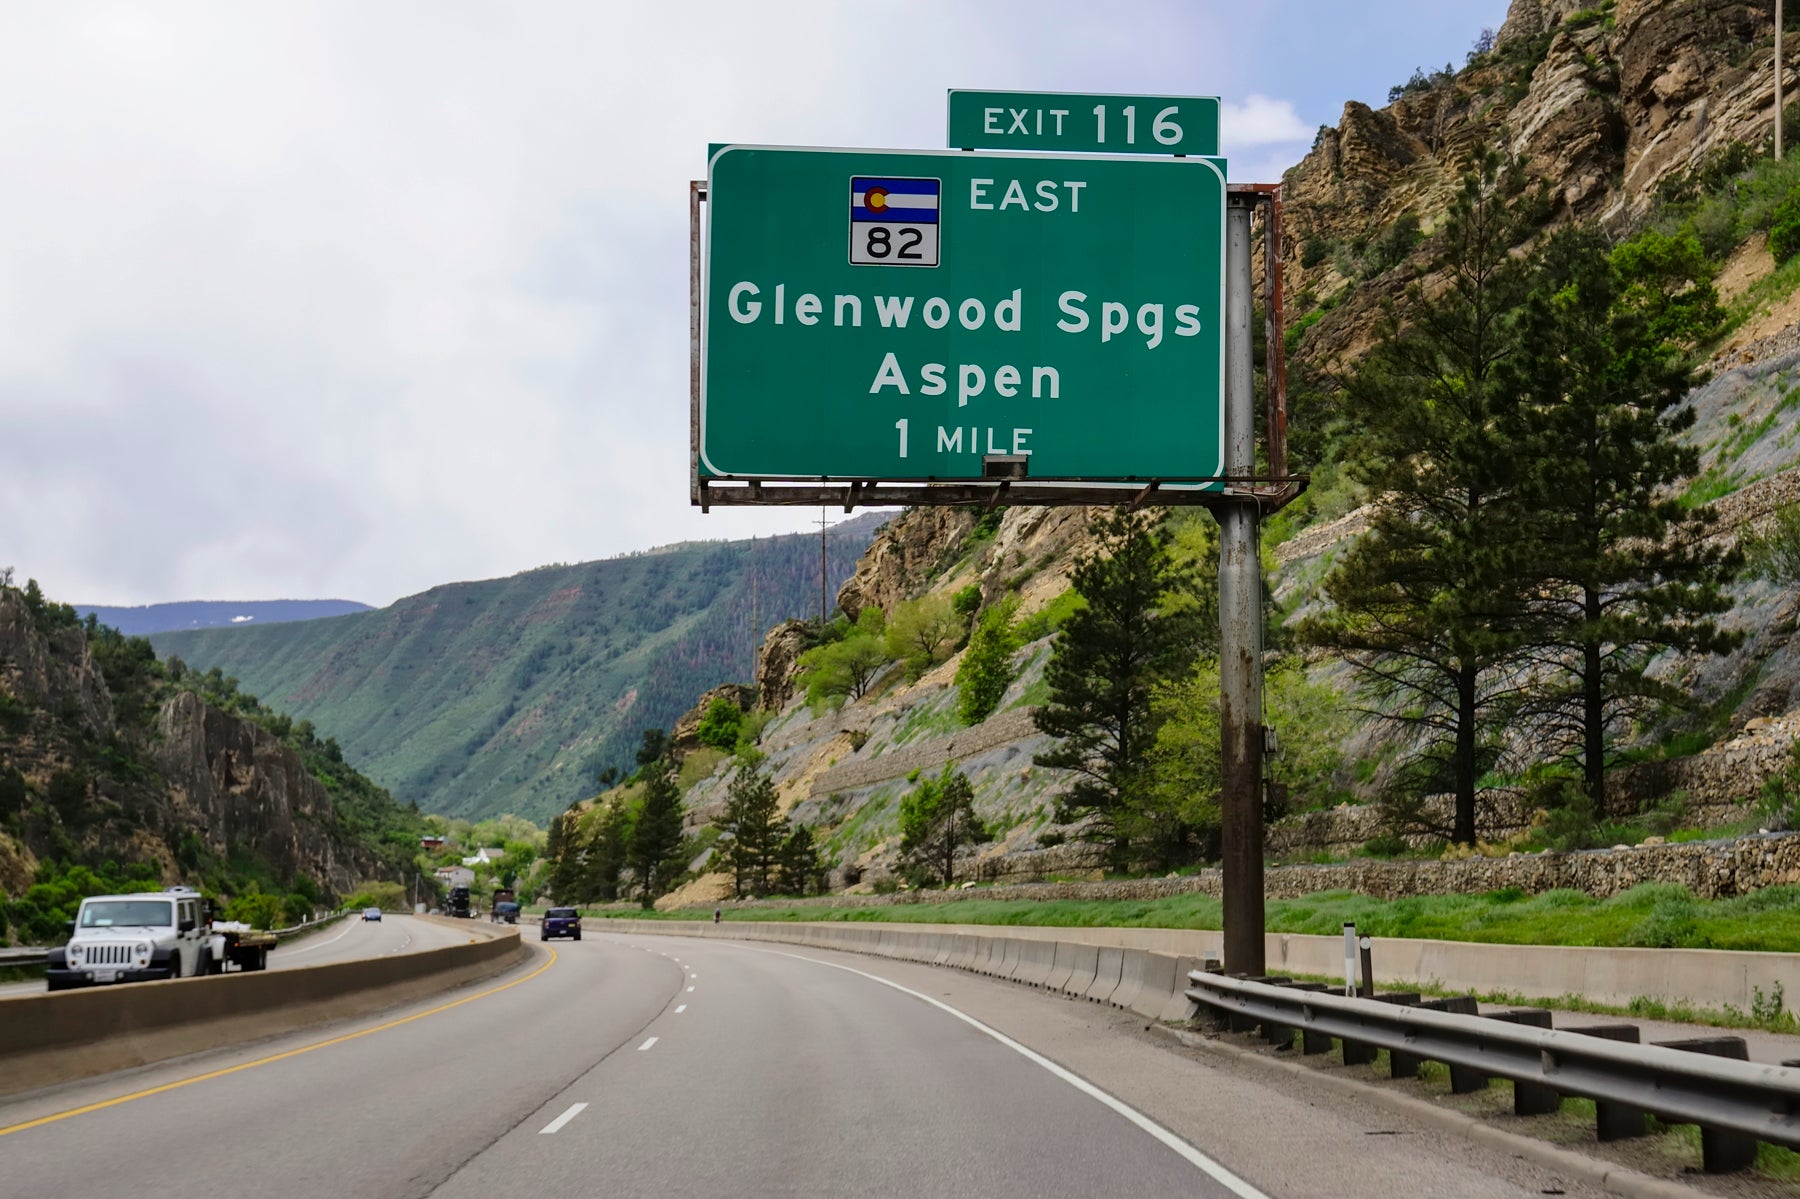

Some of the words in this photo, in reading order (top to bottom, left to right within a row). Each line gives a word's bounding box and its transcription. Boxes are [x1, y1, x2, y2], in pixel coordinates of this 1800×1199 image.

[984, 107, 1069, 136] EXIT
[1093, 105, 1184, 145] 116
[970, 178, 1087, 213] EAST
[866, 226, 924, 260] 82
[728, 280, 1022, 332] Glenwood
[1056, 290, 1202, 350] Spgs
[869, 352, 1061, 407] Aspen
[895, 418, 908, 458] 1
[937, 426, 1034, 455] MILE
